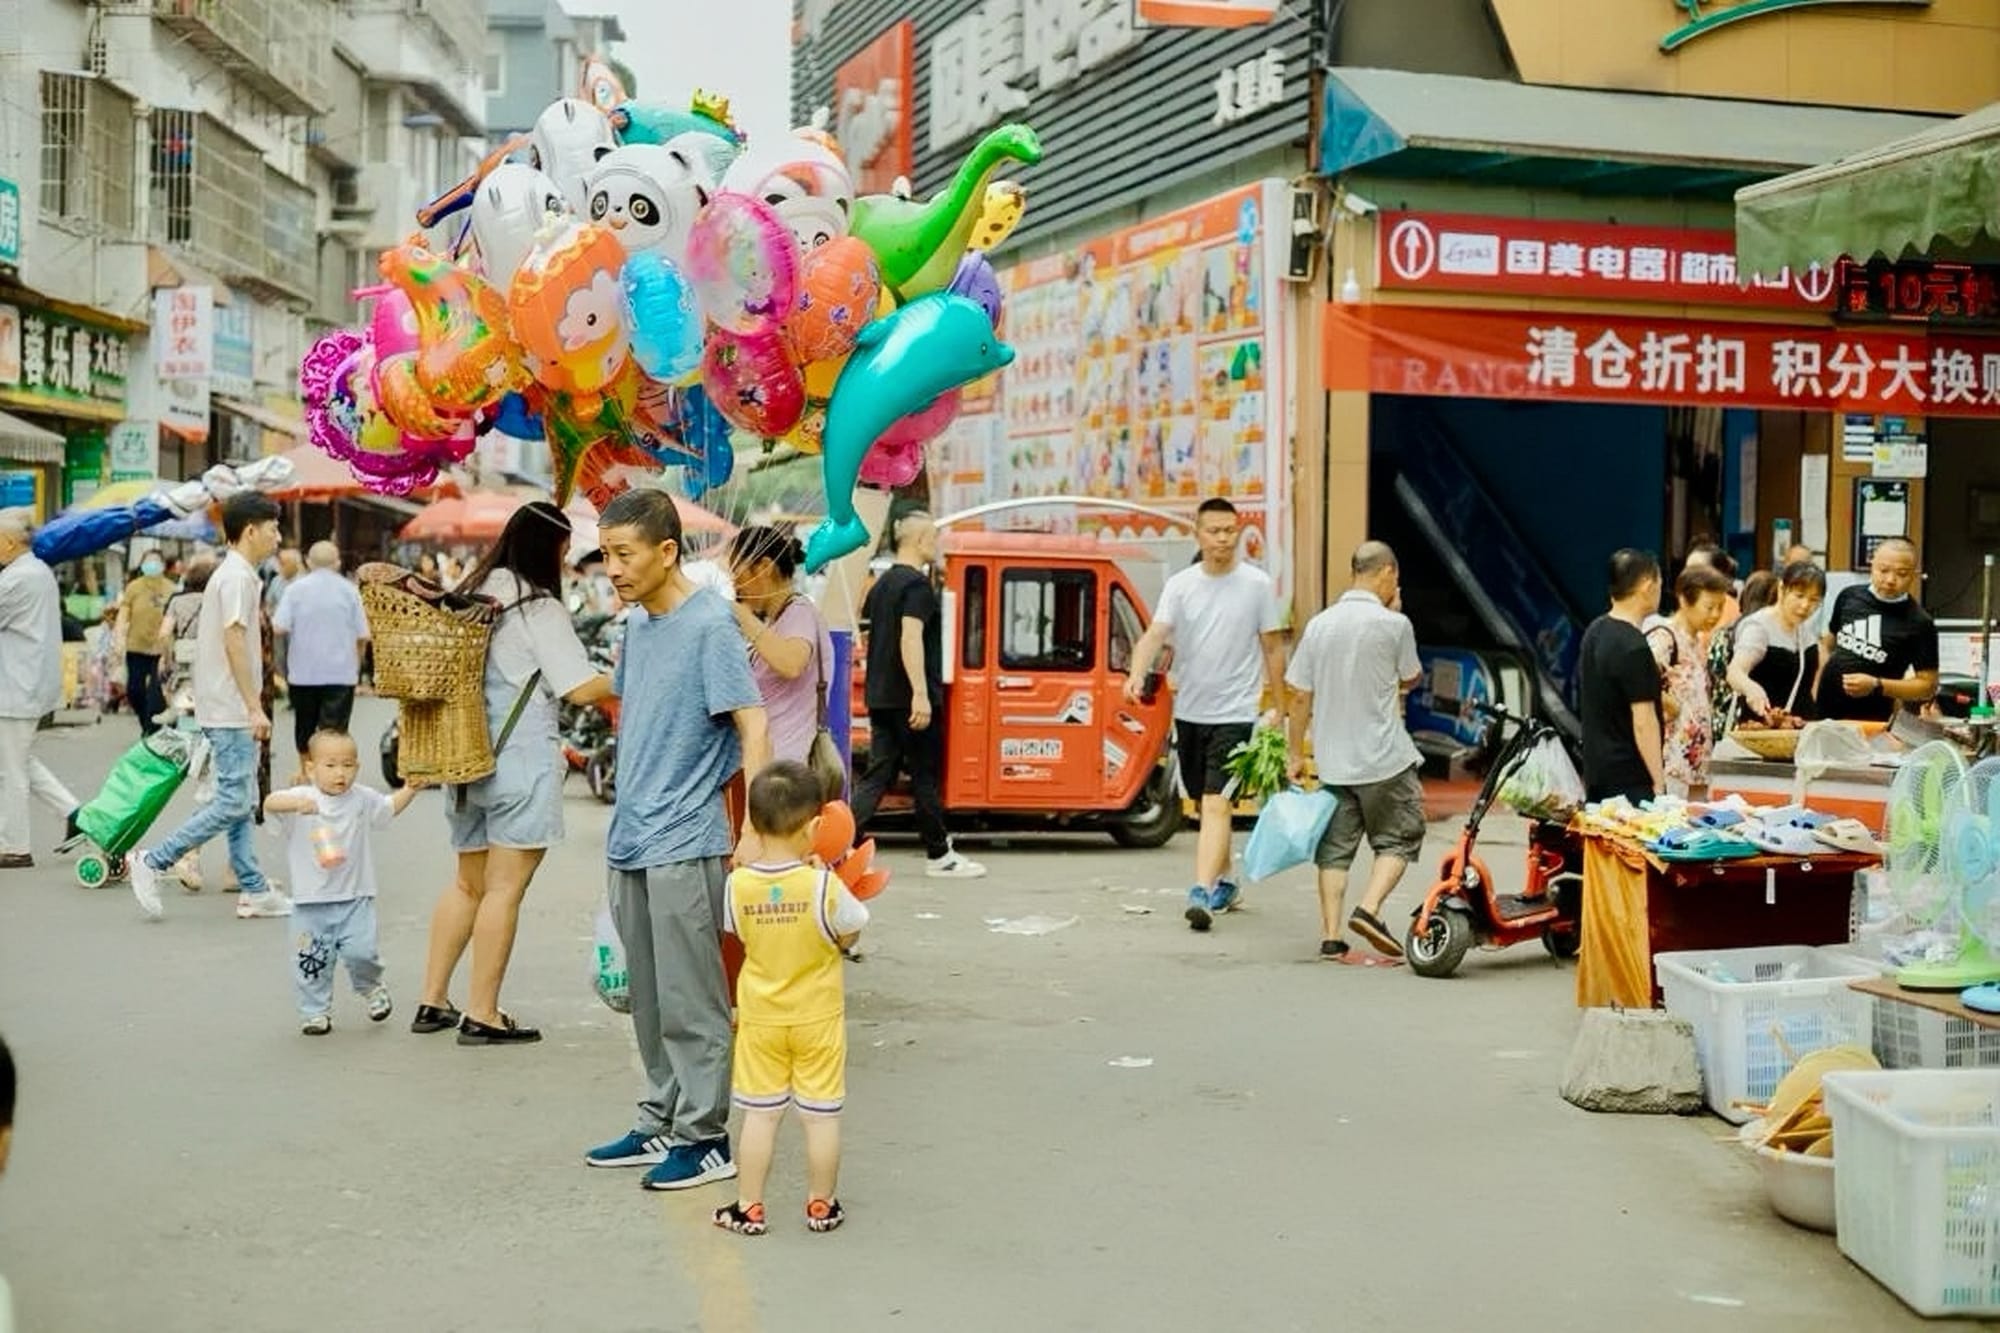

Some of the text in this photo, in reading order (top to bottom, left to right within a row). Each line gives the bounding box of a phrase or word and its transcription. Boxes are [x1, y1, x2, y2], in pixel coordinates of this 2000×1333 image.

[1506, 239, 1667, 283] 国美电器
[1525, 326, 1746, 393] 清仓折扣
